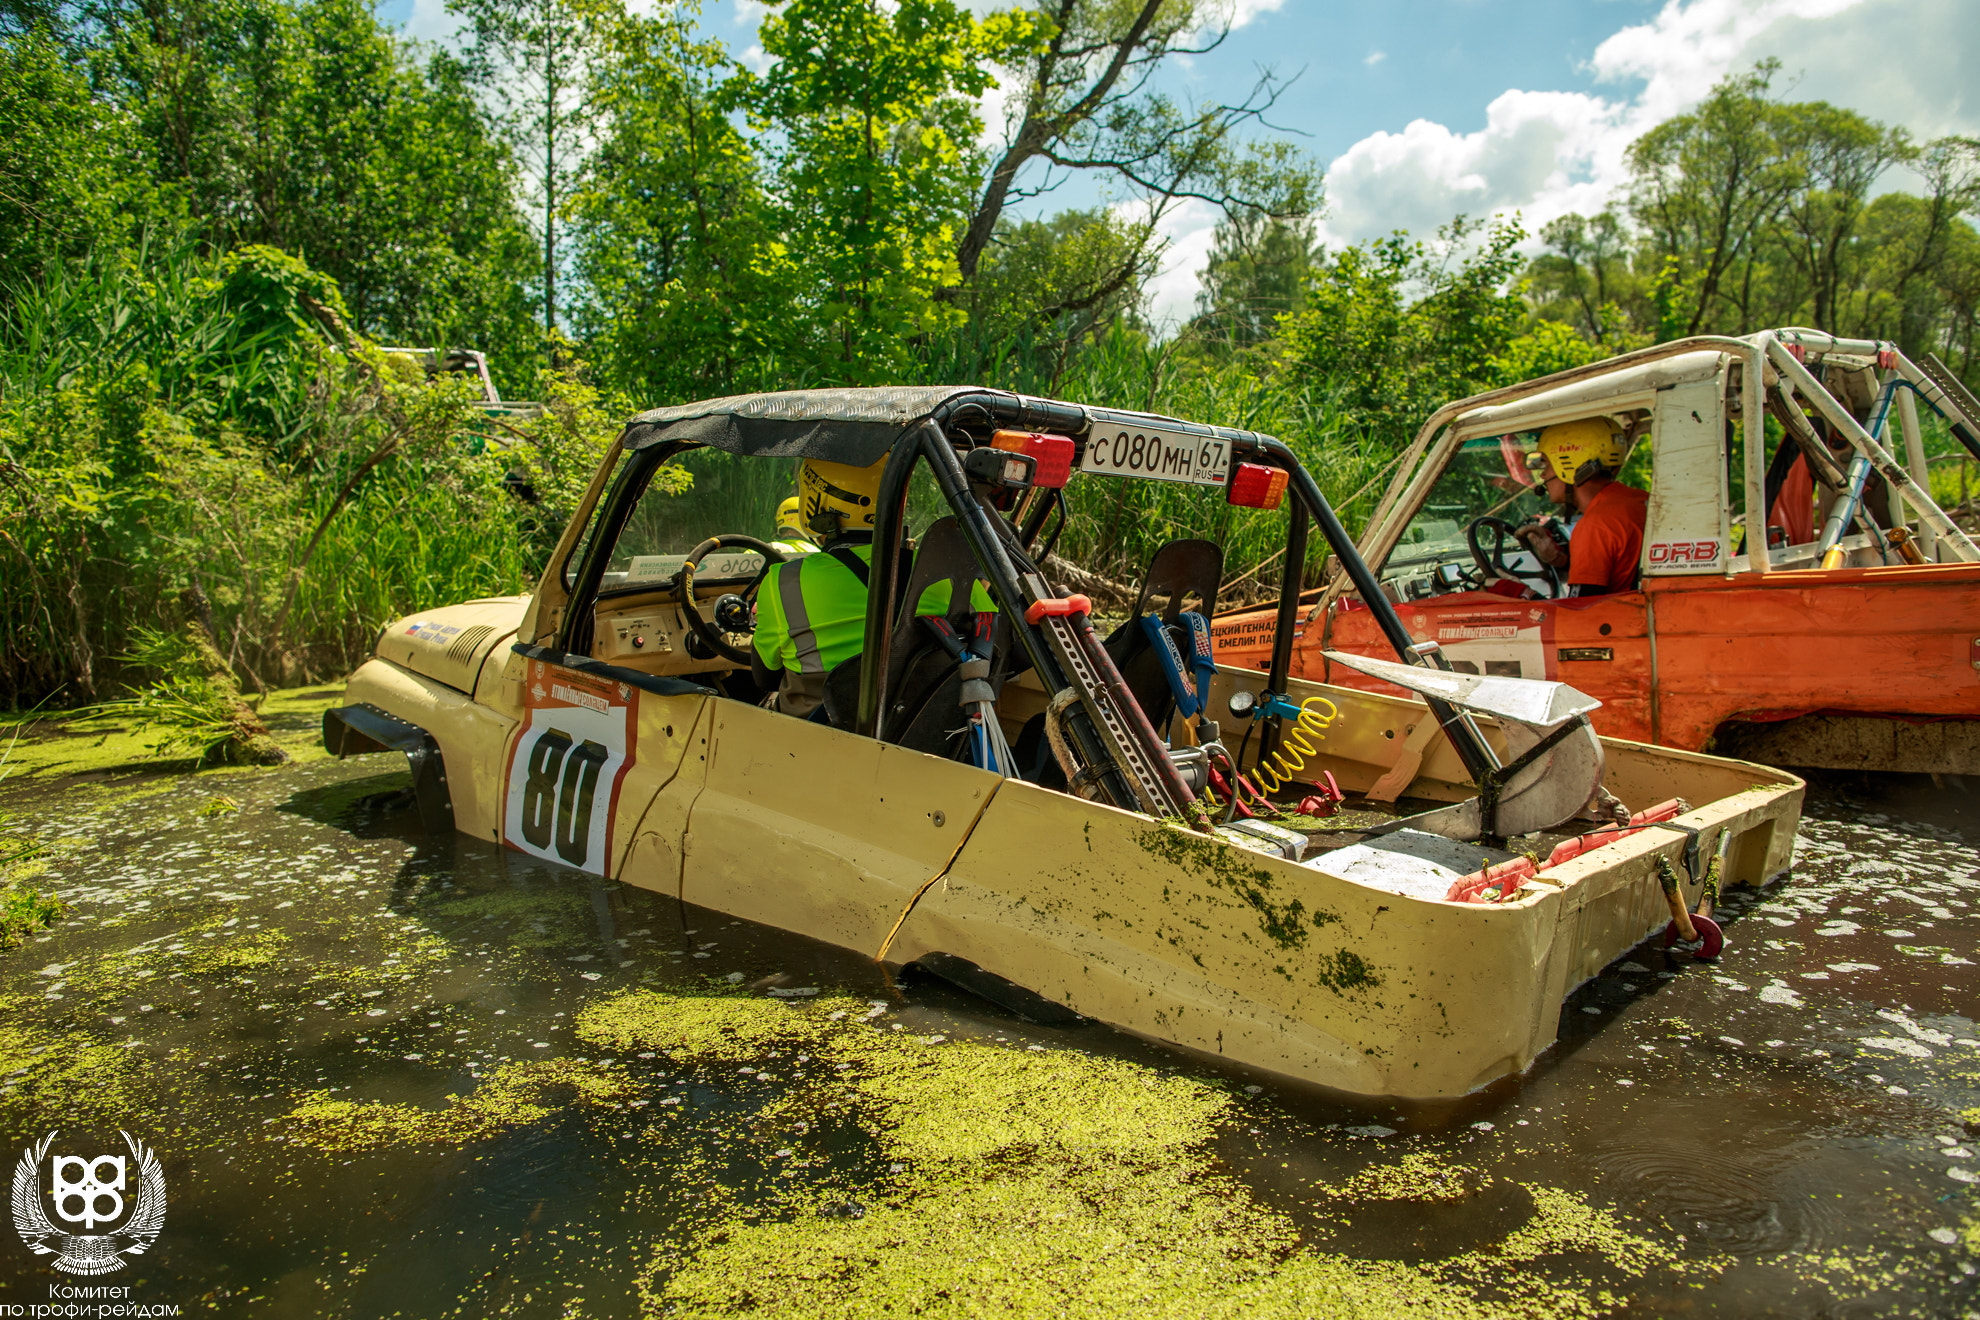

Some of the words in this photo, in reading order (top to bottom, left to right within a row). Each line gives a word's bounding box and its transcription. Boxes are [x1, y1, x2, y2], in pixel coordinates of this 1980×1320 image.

[1200, 442, 1224, 469] 67
[1195, 468, 1213, 480] RUS
[1649, 541, 1720, 562] ORB
[1210, 624, 1240, 637] ЕЦКИЙ
[1242, 621, 1277, 633] ГЕННАД
[1219, 636, 1256, 648] ЕМЕЛИН
[521, 727, 609, 868] 80
